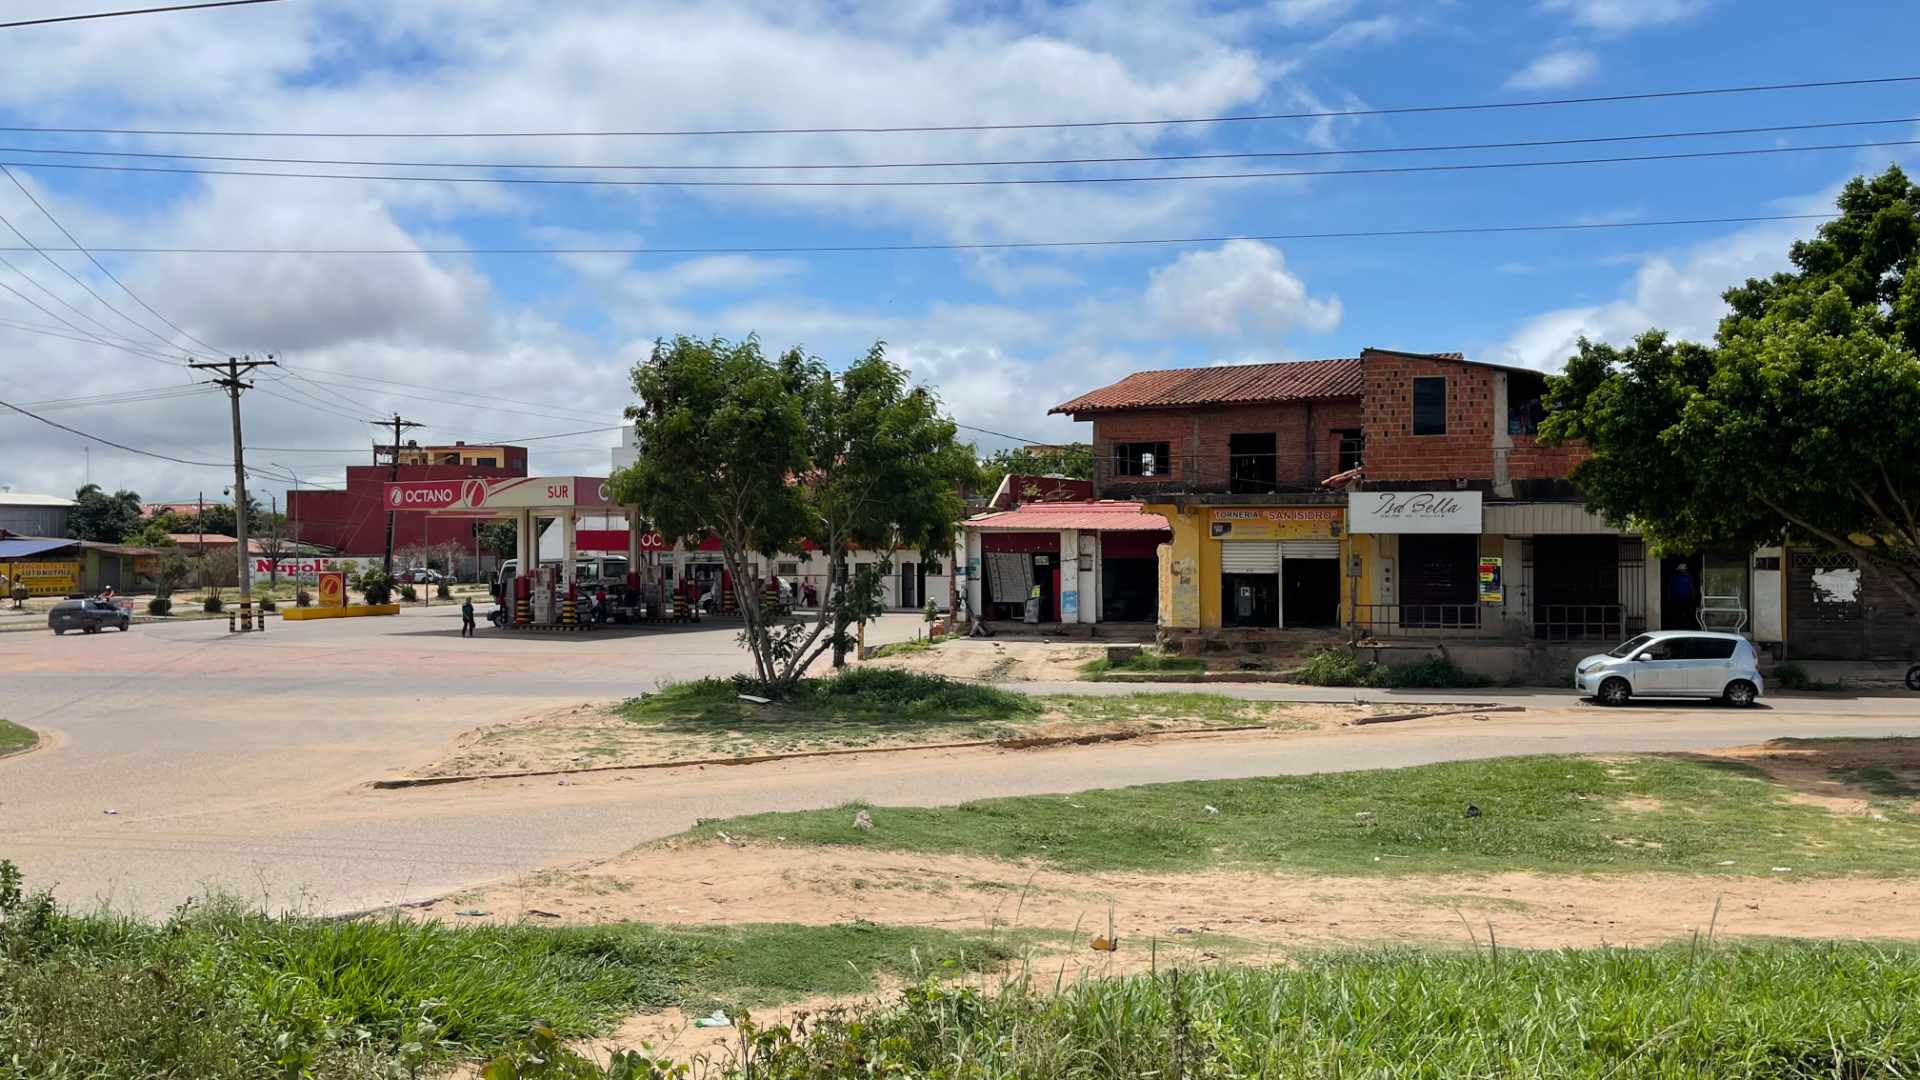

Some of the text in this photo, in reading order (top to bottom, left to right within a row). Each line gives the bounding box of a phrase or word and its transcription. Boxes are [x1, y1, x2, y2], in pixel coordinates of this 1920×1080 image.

[405, 488, 453, 503] OCTANO
[547, 485, 569, 499] SUR
[1371, 493, 1462, 514] Isa Bella
